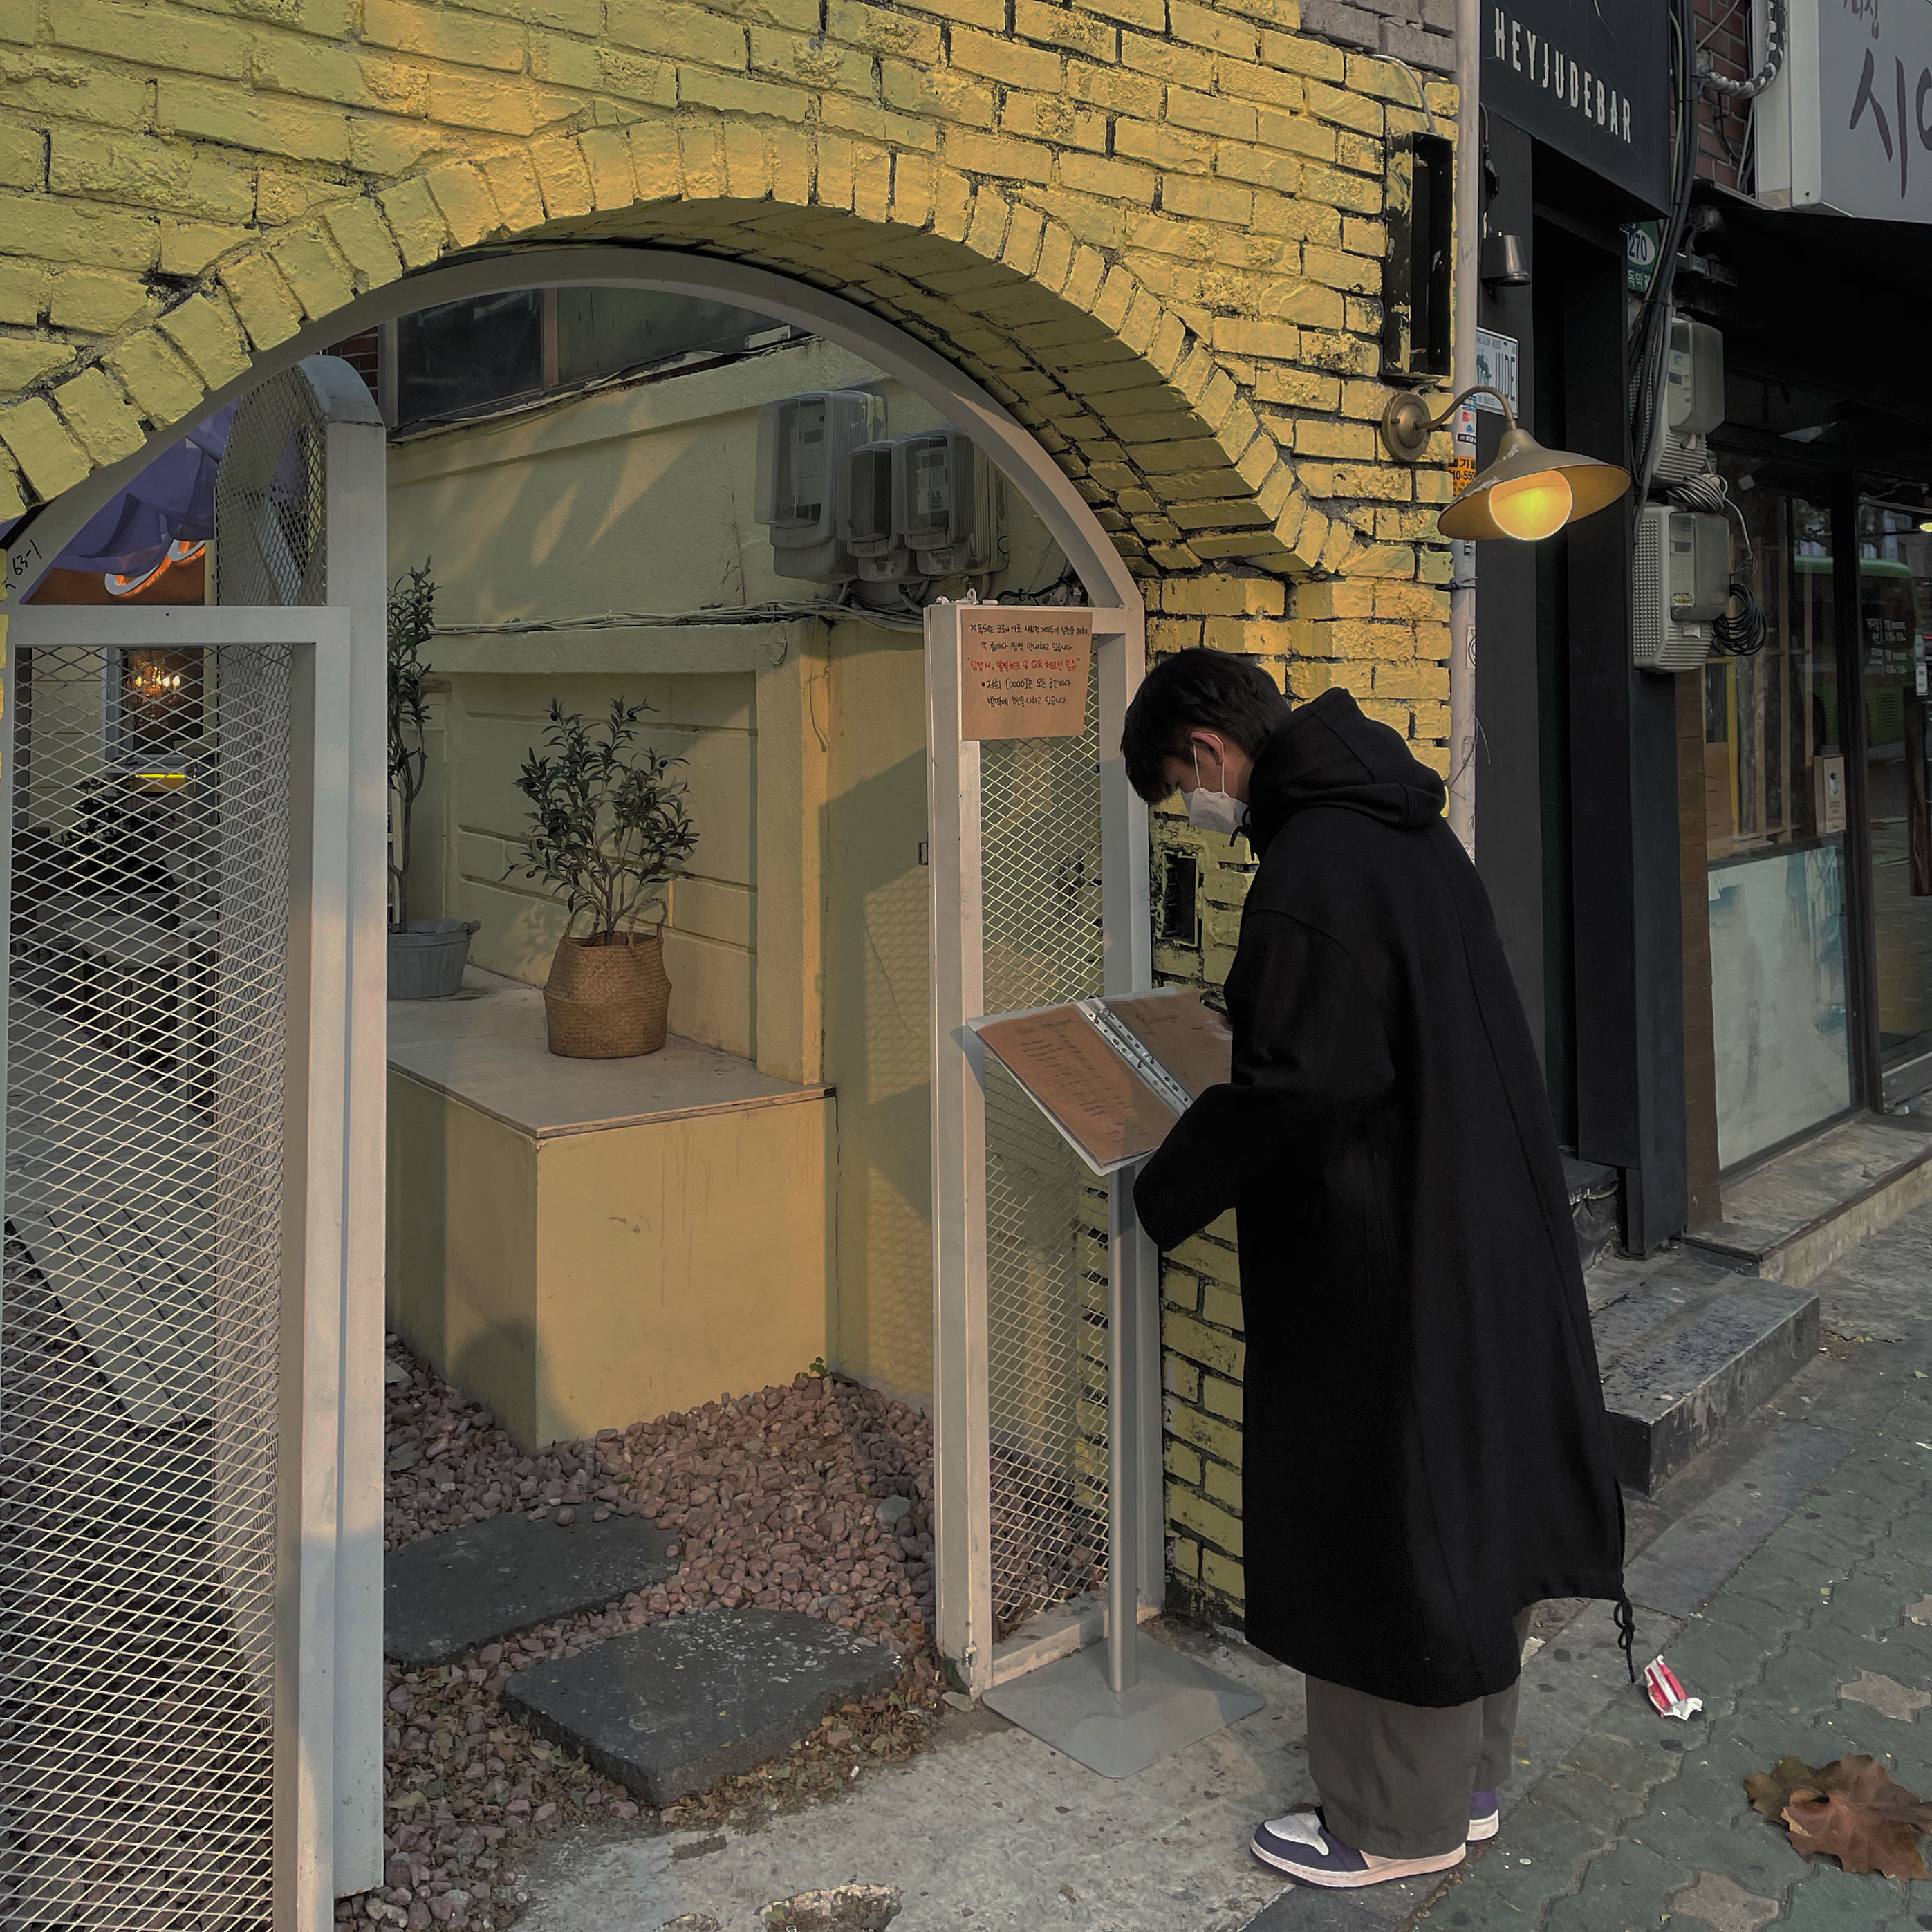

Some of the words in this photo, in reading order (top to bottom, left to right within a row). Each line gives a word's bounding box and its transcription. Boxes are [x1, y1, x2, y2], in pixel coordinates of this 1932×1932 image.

[1628, 232, 1648, 261] 270
[12, 539, 43, 575] 63-1
[969, 623, 994, 635] 계속되는
[996, 624, 1021, 633] 코로나19로
[1024, 625, 1039, 635] 사회적
[1026, 641, 1050, 652] 안내하고
[1022, 659, 1029, 670] 및
[1031, 658, 1043, 669] QR
[1044, 658, 1063, 671] 체크인
[1036, 678, 1046, 689] 모든
[1049, 677, 1072, 689] 공간마다
[987, 696, 1009, 708] 방역에
[1011, 695, 1025, 707] 최선을
[1025, 696, 1042, 704] 다하고
